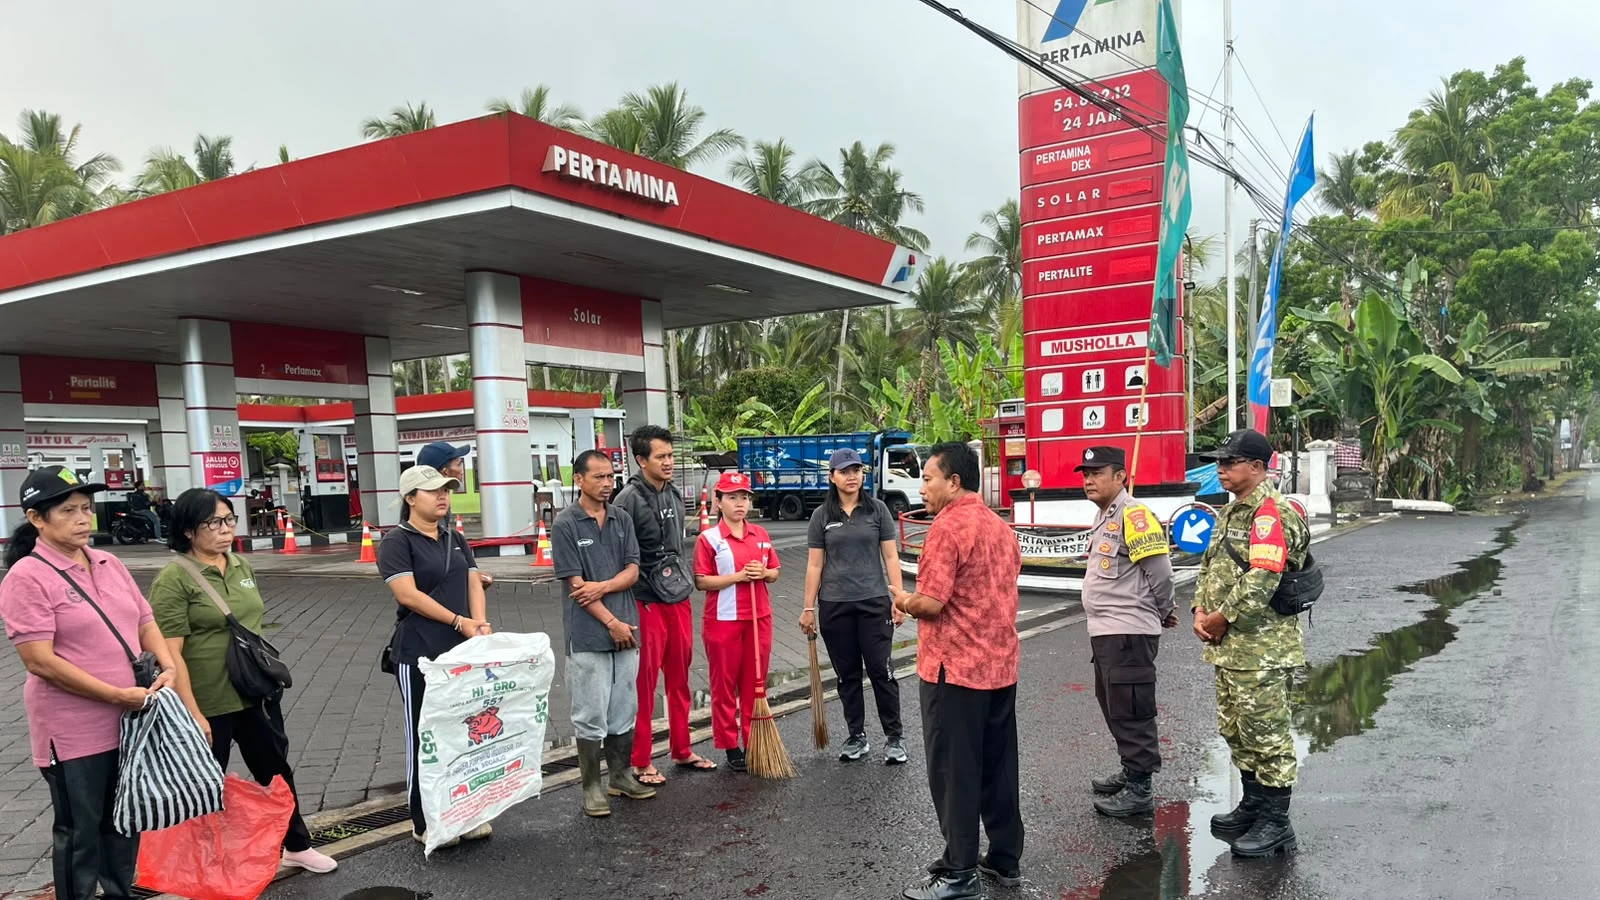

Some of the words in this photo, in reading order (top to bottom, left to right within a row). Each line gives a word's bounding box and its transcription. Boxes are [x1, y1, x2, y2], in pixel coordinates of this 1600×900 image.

[1040, 30, 1146, 66] PERTAMINA
[1063, 116, 1082, 132] 24
[1036, 145, 1092, 166] PERTAMINA
[1071, 159, 1092, 172] DEX
[552, 145, 680, 206] PERTAMINA
[1037, 188, 1101, 208] SOLAR
[1037, 226, 1104, 246] PERTAMAX
[1038, 265, 1093, 282] PERTALITE
[573, 307, 602, 326] Solar
[1051, 334, 1136, 354] MUSHOLLA
[284, 363, 322, 377] Pertamax
[70, 375, 117, 389] Pertalite
[1228, 529, 1239, 538] TNI
[1021, 545, 1042, 554] DAN
[1046, 544, 1088, 554] TERSE
[472, 687, 484, 698] HI
[483, 696, 504, 708] 551
[420, 729, 439, 764] 551
